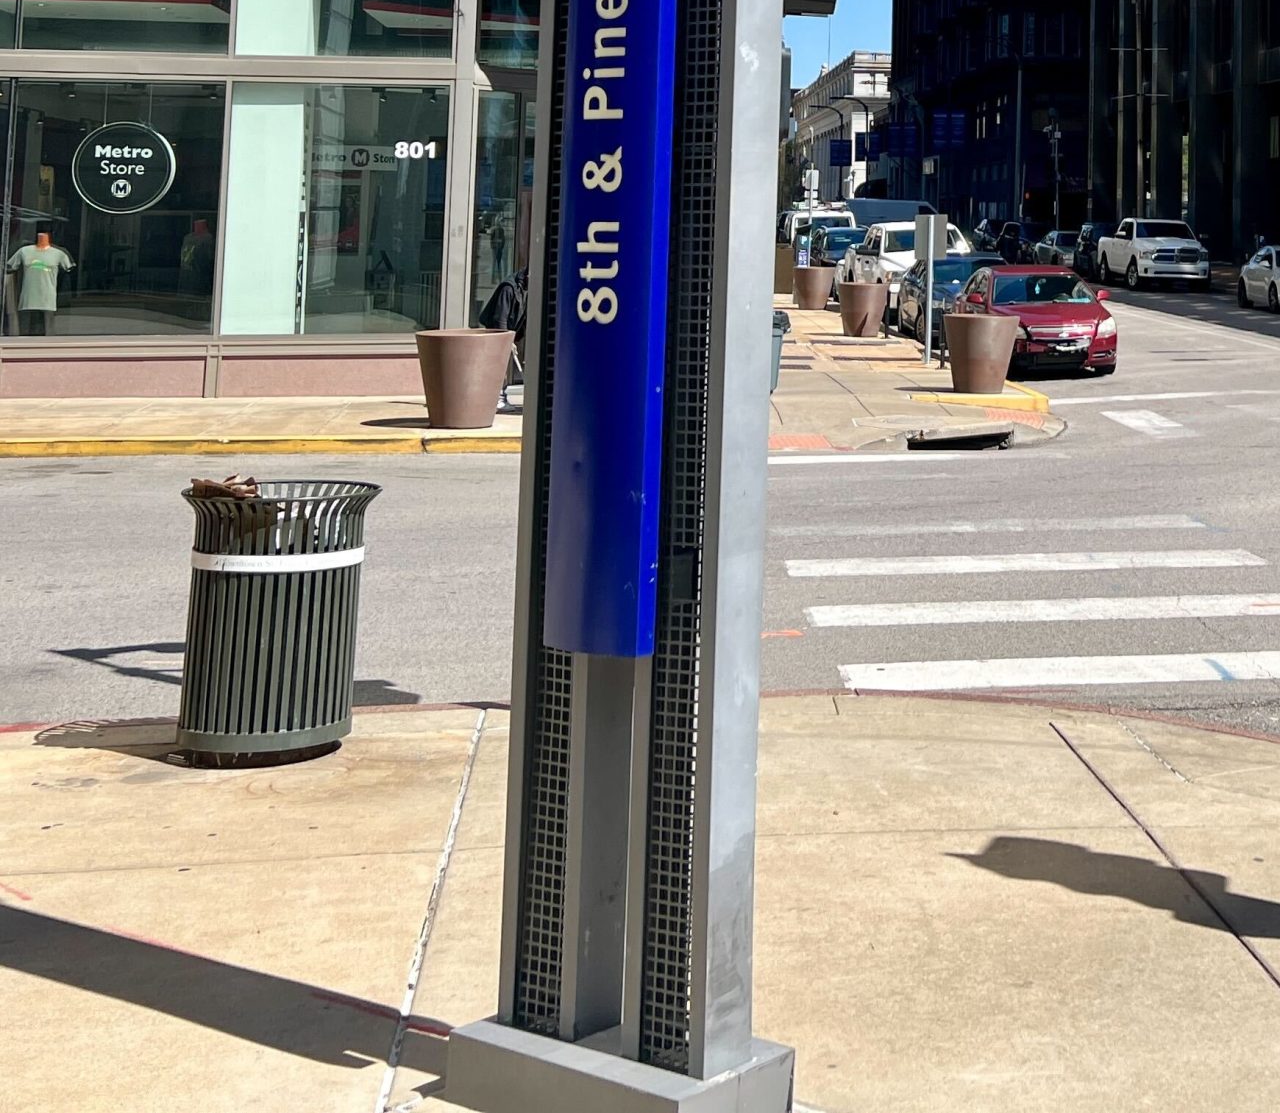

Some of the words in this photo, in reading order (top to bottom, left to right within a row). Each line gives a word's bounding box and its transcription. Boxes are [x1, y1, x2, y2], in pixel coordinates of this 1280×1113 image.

[94, 144, 153, 159] Metro
[394, 141, 437, 159] 801
[100, 160, 145, 176] Store
[582, 145, 623, 193] &
[577, 220, 620, 325] 8th
